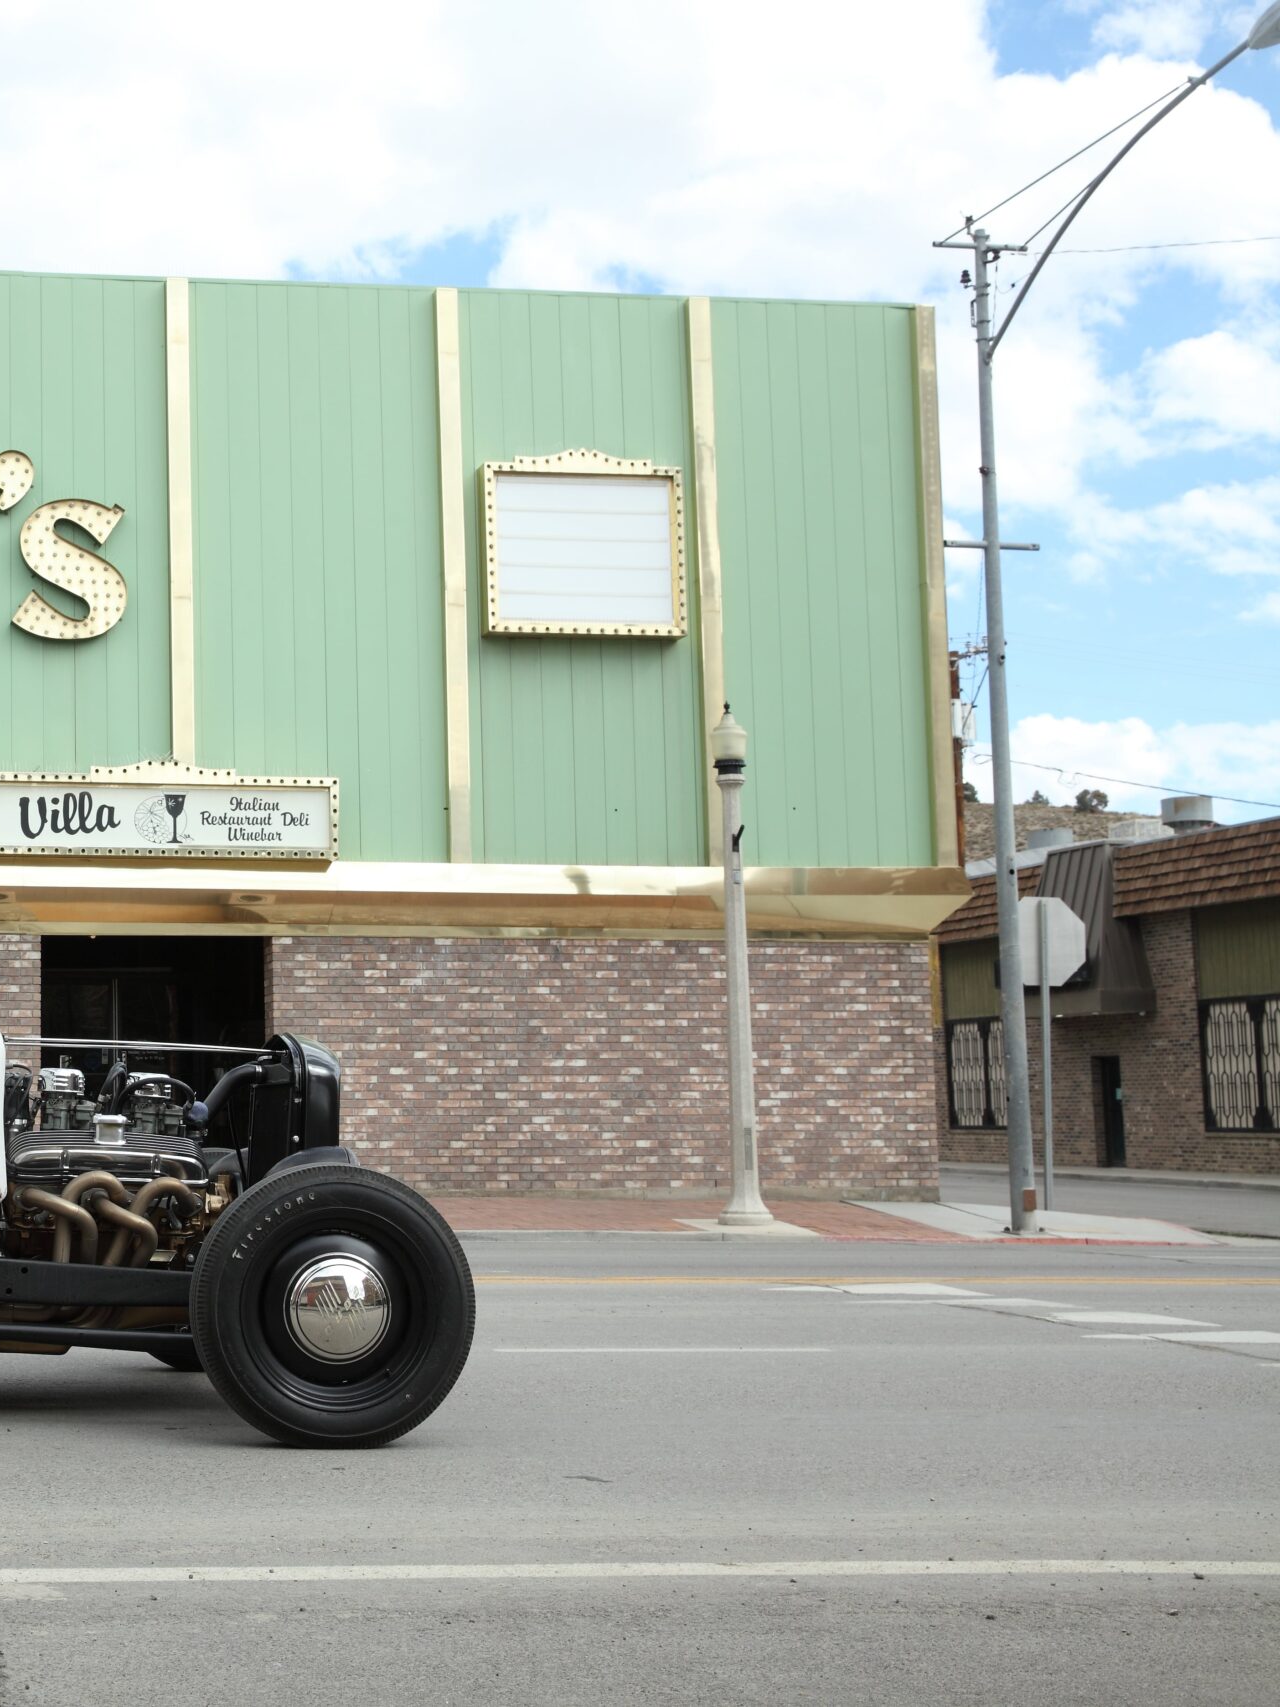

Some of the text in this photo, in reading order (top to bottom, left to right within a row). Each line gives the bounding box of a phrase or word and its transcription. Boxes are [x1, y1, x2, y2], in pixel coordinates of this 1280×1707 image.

[229, 796, 281, 812] Italian
[19, 791, 121, 839] Villa
[200, 810, 310, 827] Restaurant Deli
[227, 826, 283, 842] Winebar
[231, 1190, 316, 1261] Firestone
